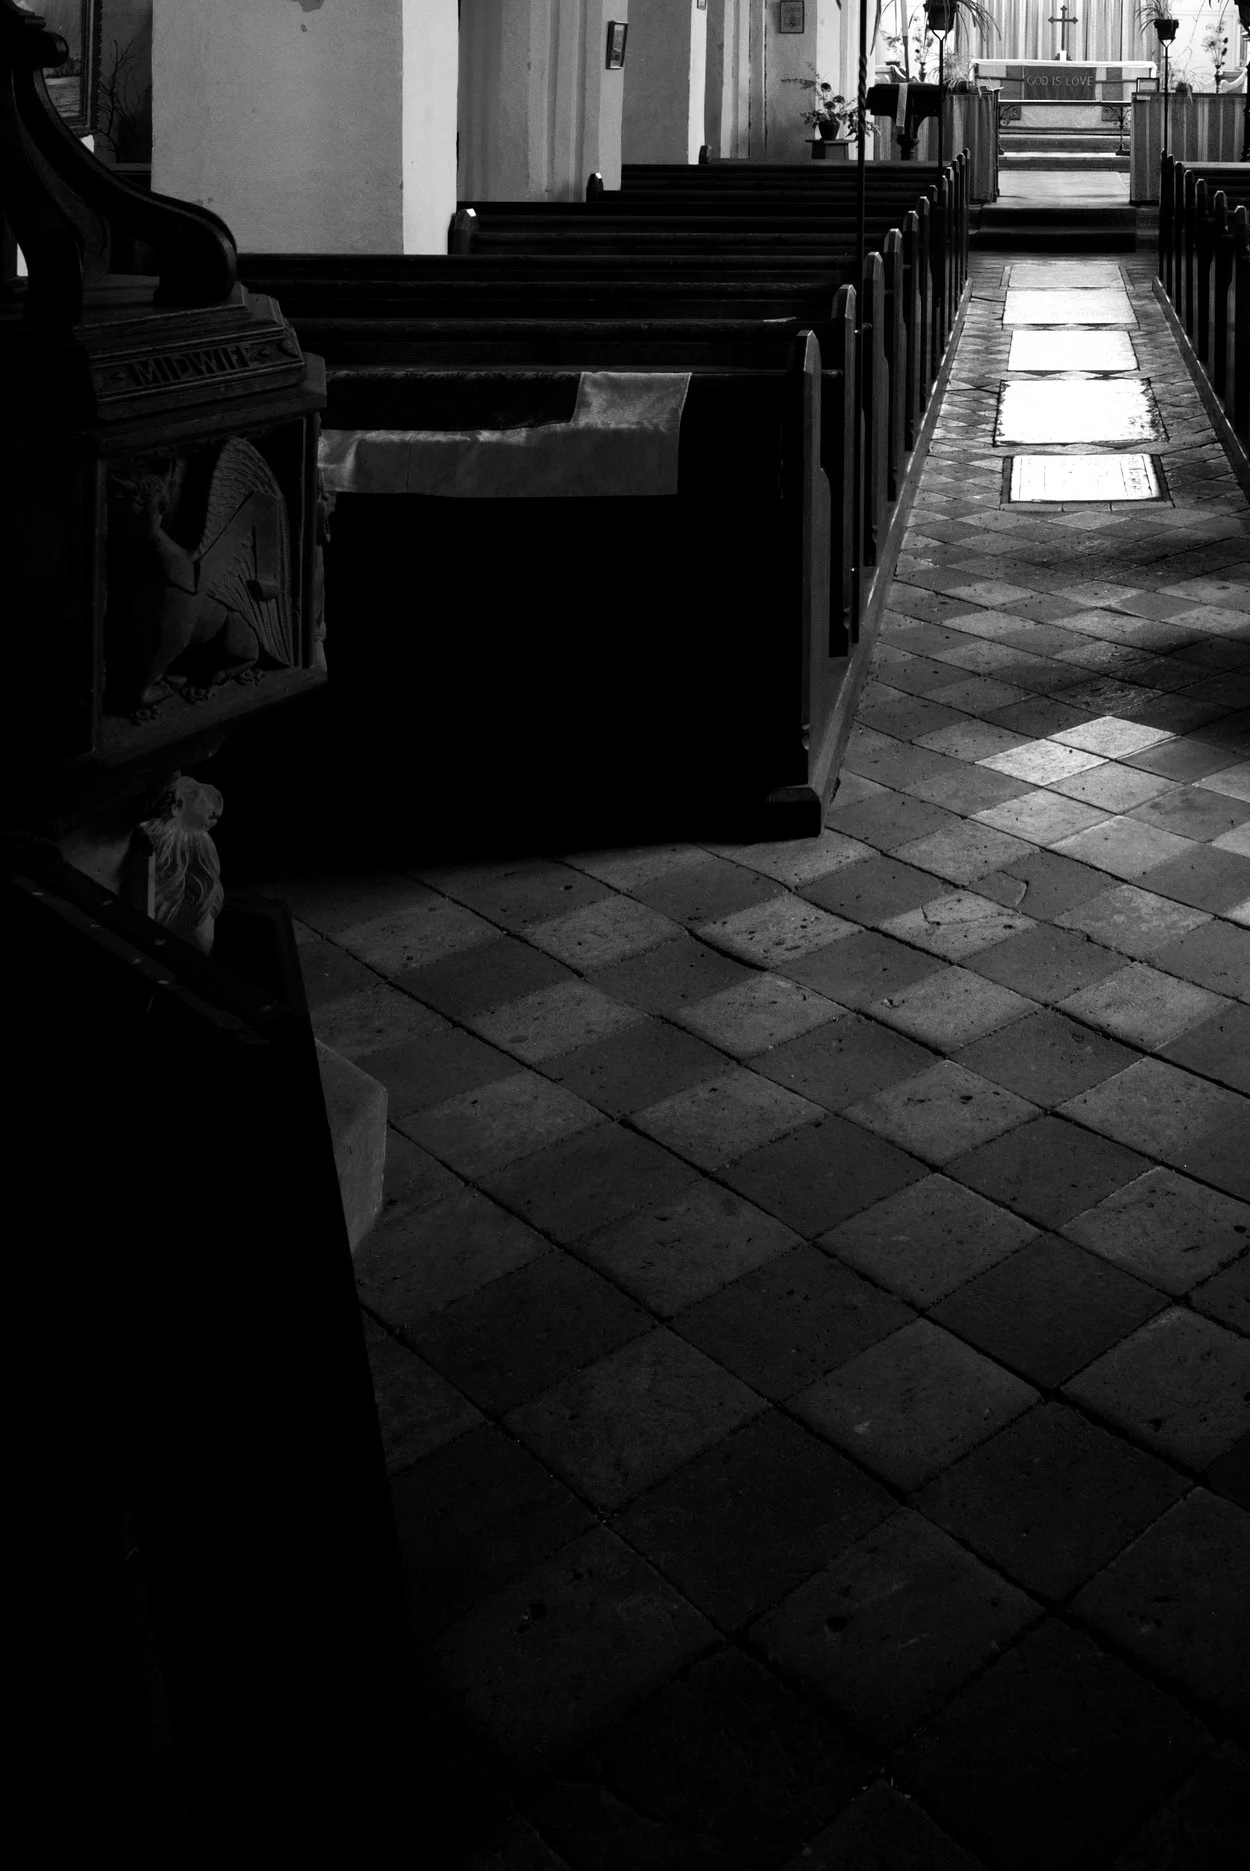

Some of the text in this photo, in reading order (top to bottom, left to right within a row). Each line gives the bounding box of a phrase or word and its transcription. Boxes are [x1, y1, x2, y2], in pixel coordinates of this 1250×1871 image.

[1027, 75, 1095, 87] GOD IS LOVE
